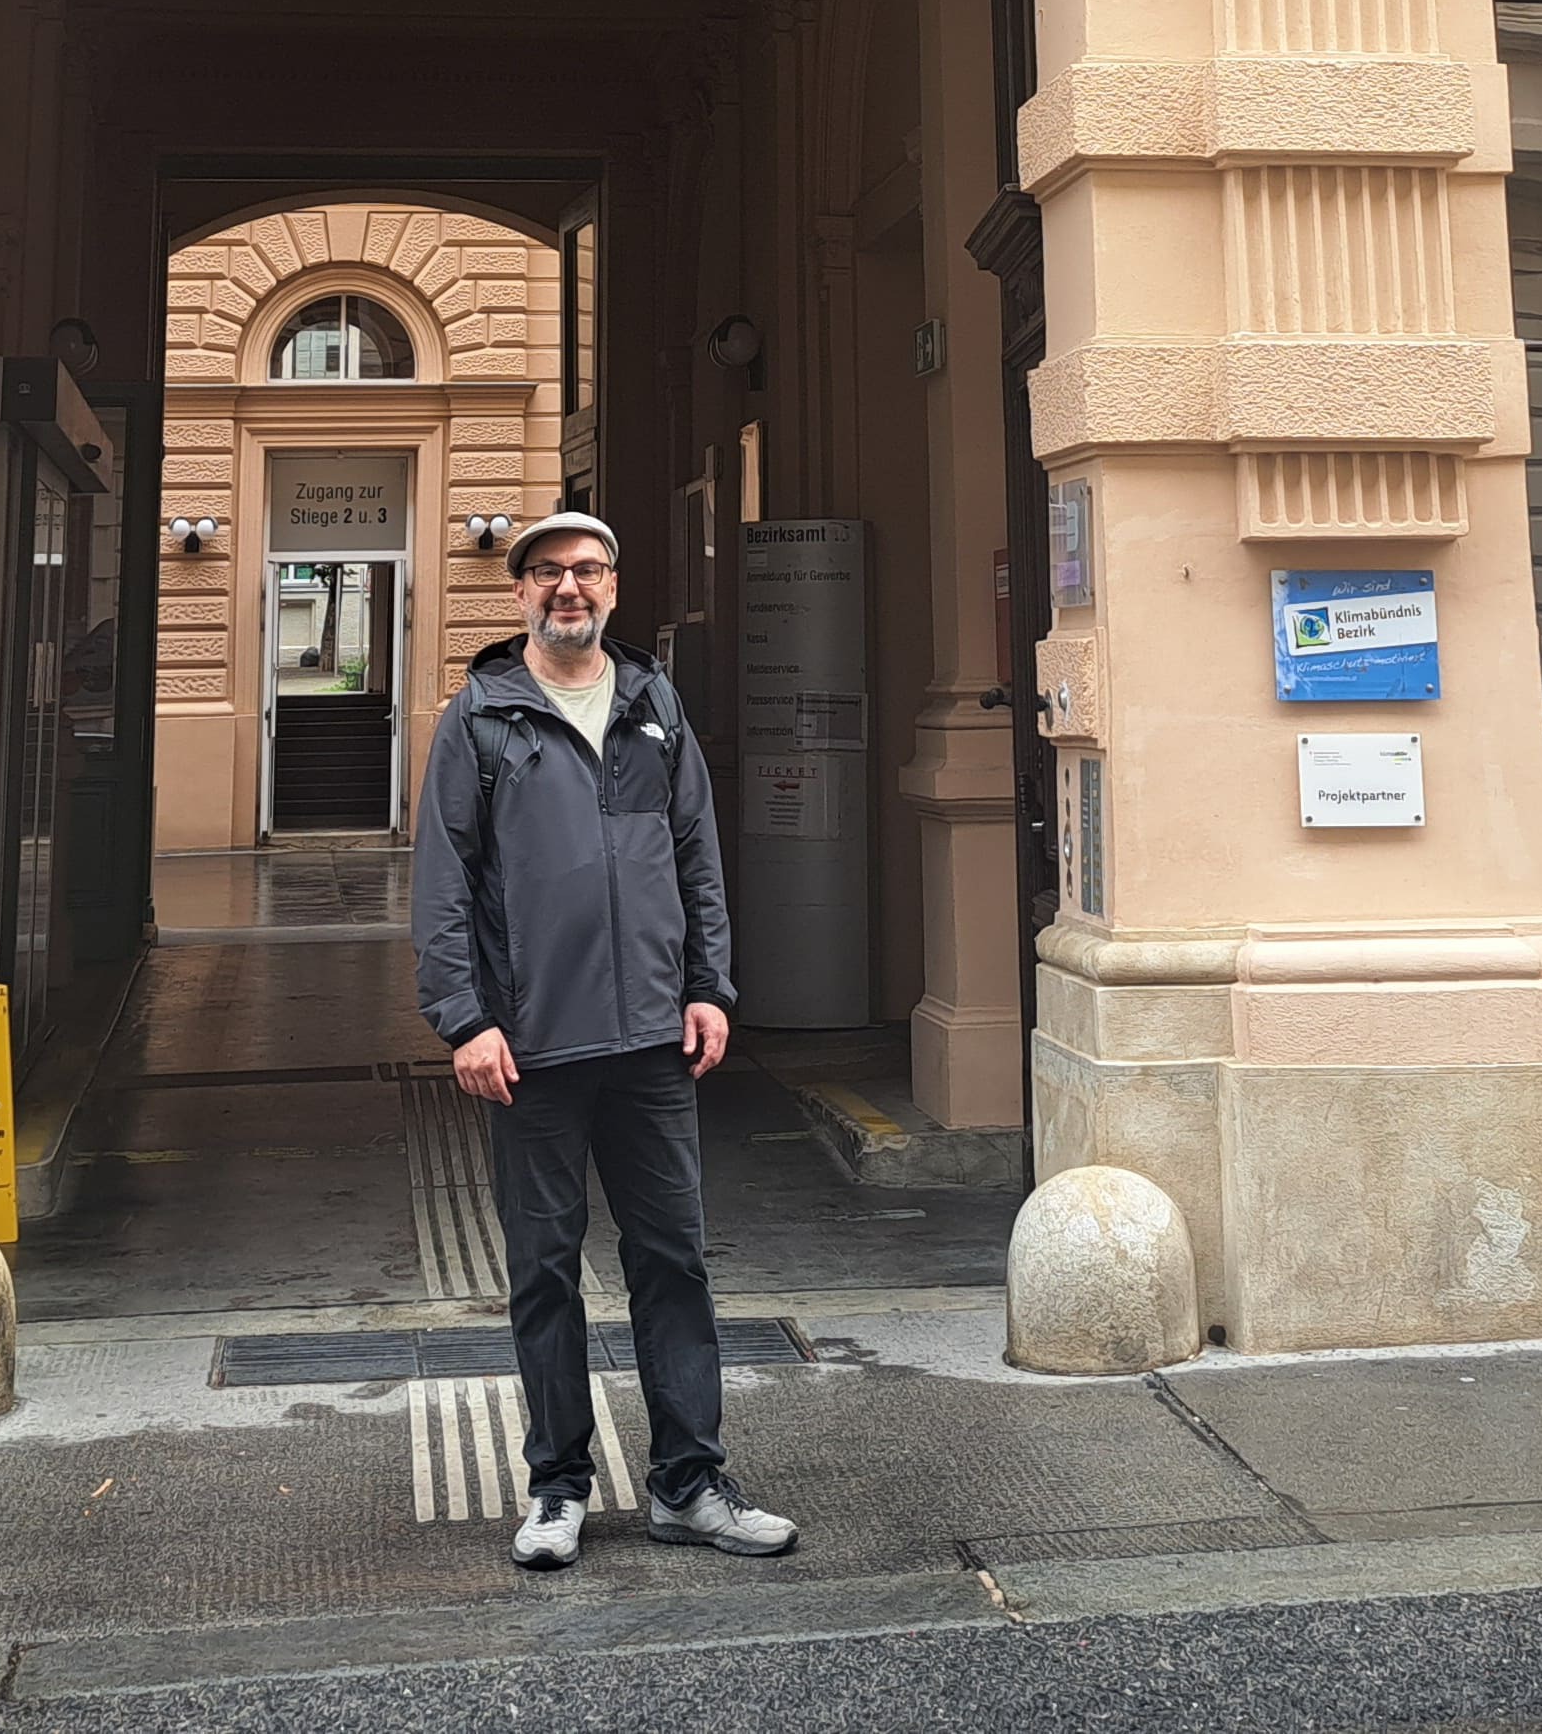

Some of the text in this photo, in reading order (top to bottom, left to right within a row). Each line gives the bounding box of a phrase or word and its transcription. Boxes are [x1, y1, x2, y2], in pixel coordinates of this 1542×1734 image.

[296, 483, 384, 503] Zugang zur
[290, 507, 387, 527] Stiege 2 u. 3
[746, 526, 827, 544] Bezirksamt
[794, 570, 807, 581] für
[810, 569, 851, 581] Gewerbe
[1332, 578, 1391, 596] Wir sind
[1335, 603, 1422, 624] Klimabündnis
[1337, 624, 1376, 640] Bezirk
[758, 766, 818, 776] TICKET
[1318, 789, 1407, 804] Projektpartner
